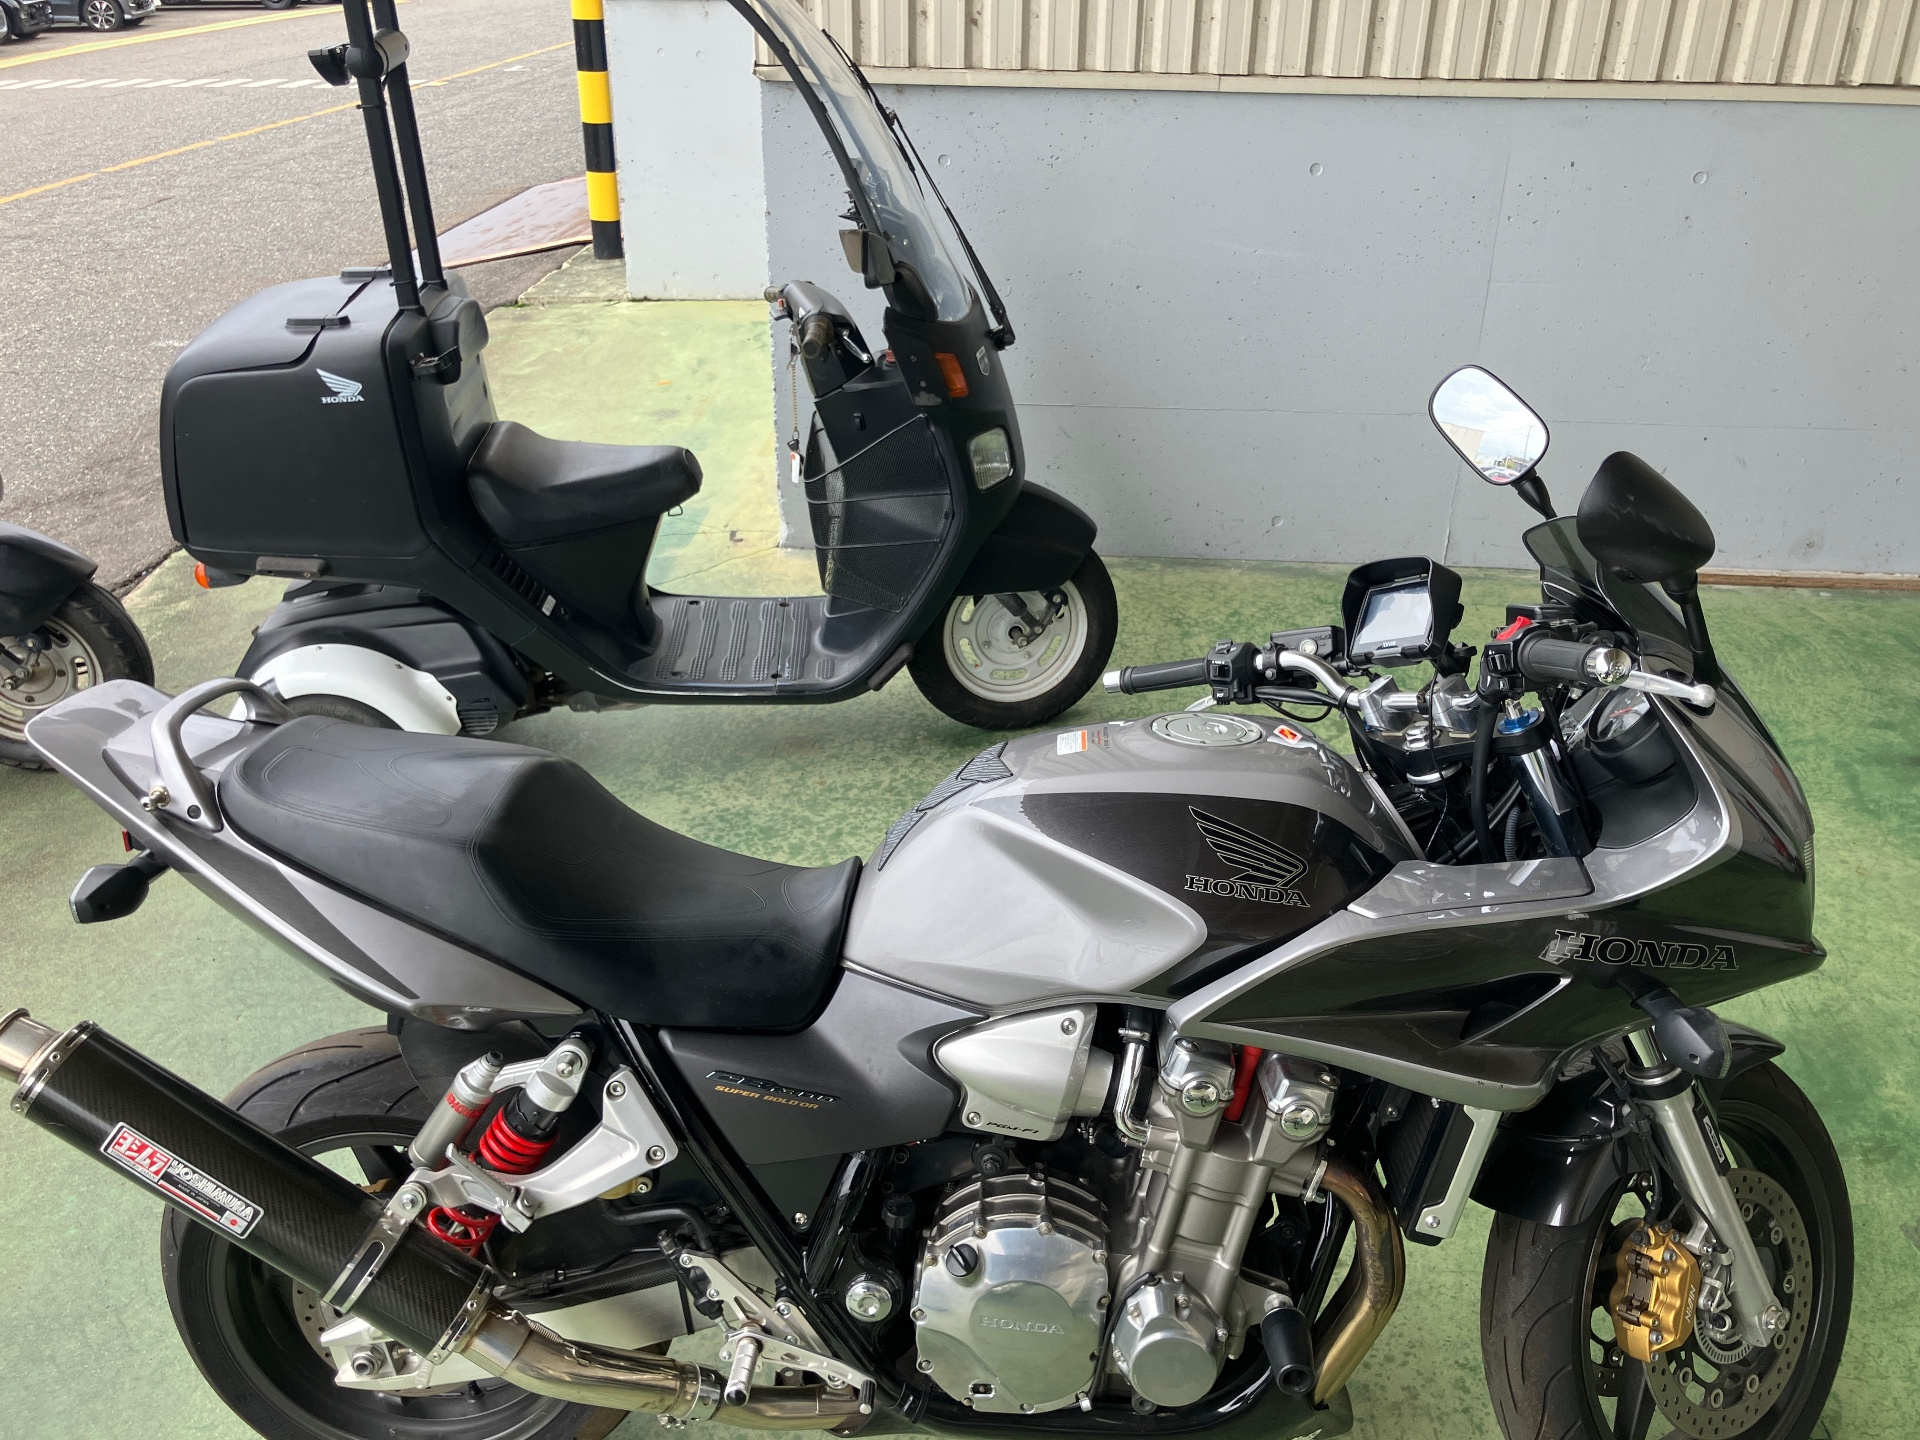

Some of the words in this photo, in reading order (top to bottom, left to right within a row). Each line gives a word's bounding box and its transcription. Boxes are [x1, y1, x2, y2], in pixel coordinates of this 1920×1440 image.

[320, 395, 365, 404] HONDA
[1184, 875, 1311, 908] HONDA
[1549, 929, 1739, 971] HONDA
[714, 1085, 761, 1099] SUPER
[113, 1131, 168, 1173] ヨシムラ
[166, 1159, 255, 1222] YOSHIMURA
[979, 1316, 1065, 1335] HONDA
